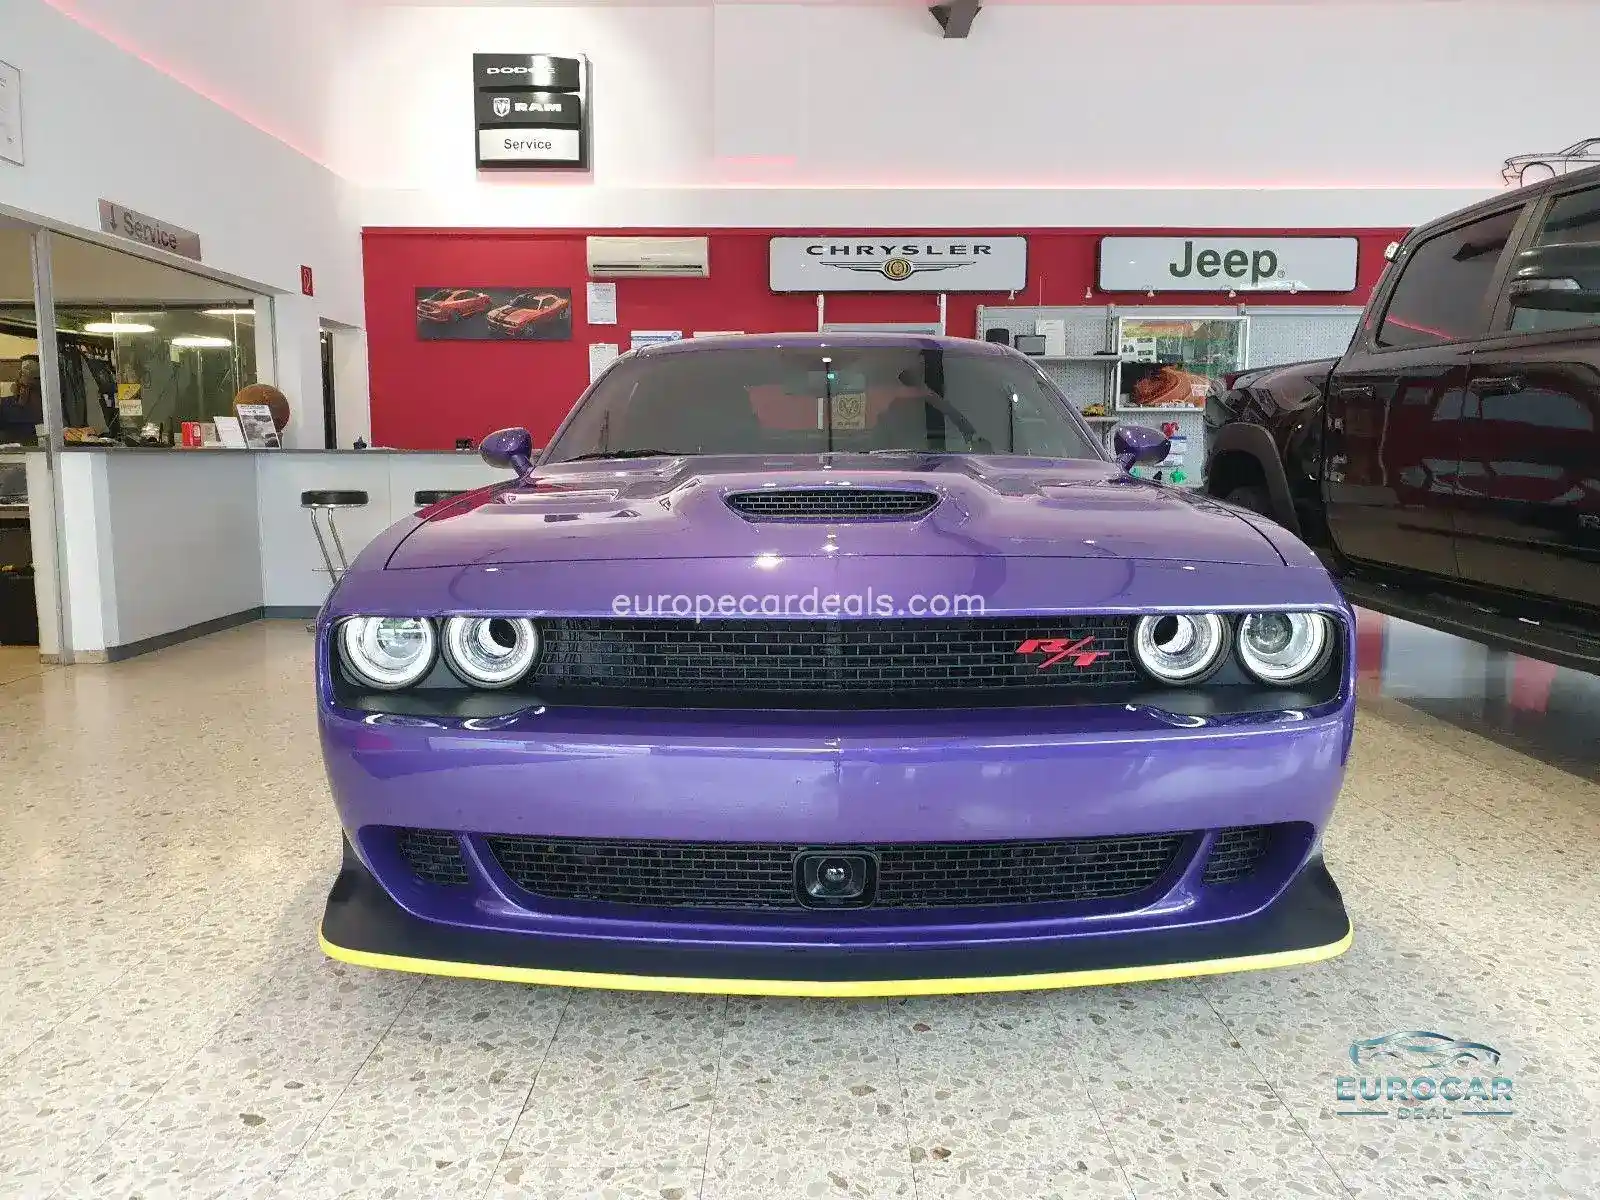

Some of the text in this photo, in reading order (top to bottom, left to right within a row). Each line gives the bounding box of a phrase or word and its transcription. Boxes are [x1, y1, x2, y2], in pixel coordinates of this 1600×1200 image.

[514, 102, 562, 112] RAM
[504, 138, 552, 150] Service
[123, 211, 178, 250] Service
[806, 245, 991, 255] CHRYSLER
[1169, 241, 1278, 287] Jeep
[1016, 635, 1110, 668] R/T
